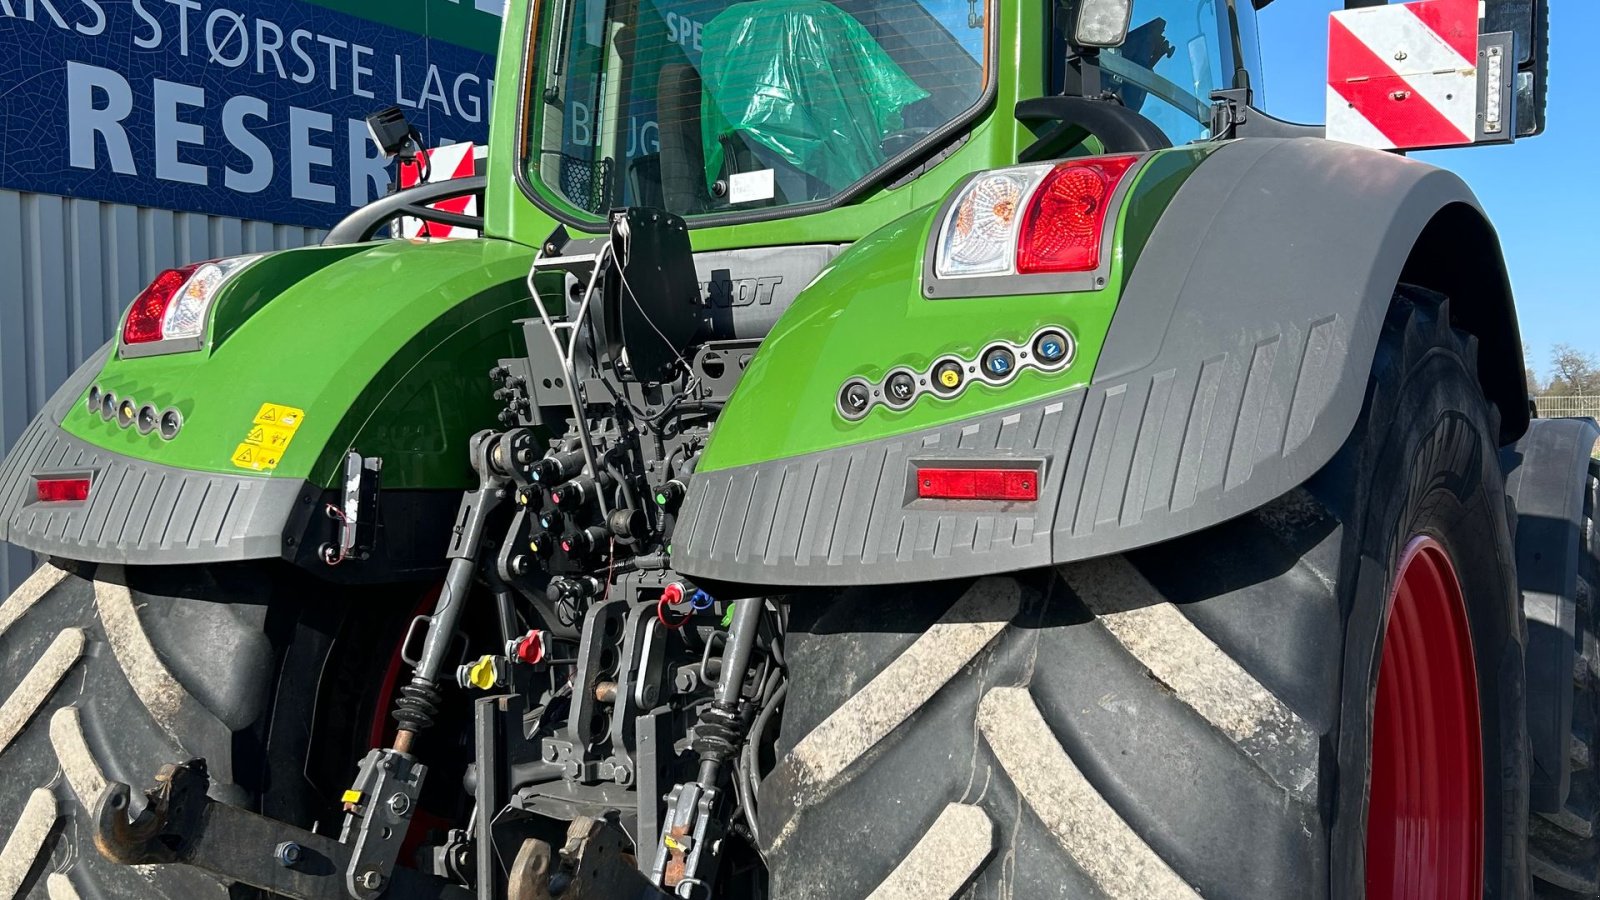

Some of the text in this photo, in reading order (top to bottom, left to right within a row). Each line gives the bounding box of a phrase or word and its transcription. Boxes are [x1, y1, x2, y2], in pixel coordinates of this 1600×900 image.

[132, 0, 375, 99] STØRSTE
[394, 54, 494, 126] LAG
[66, 60, 456, 208] RESER
[698, 275, 783, 308] NDT
